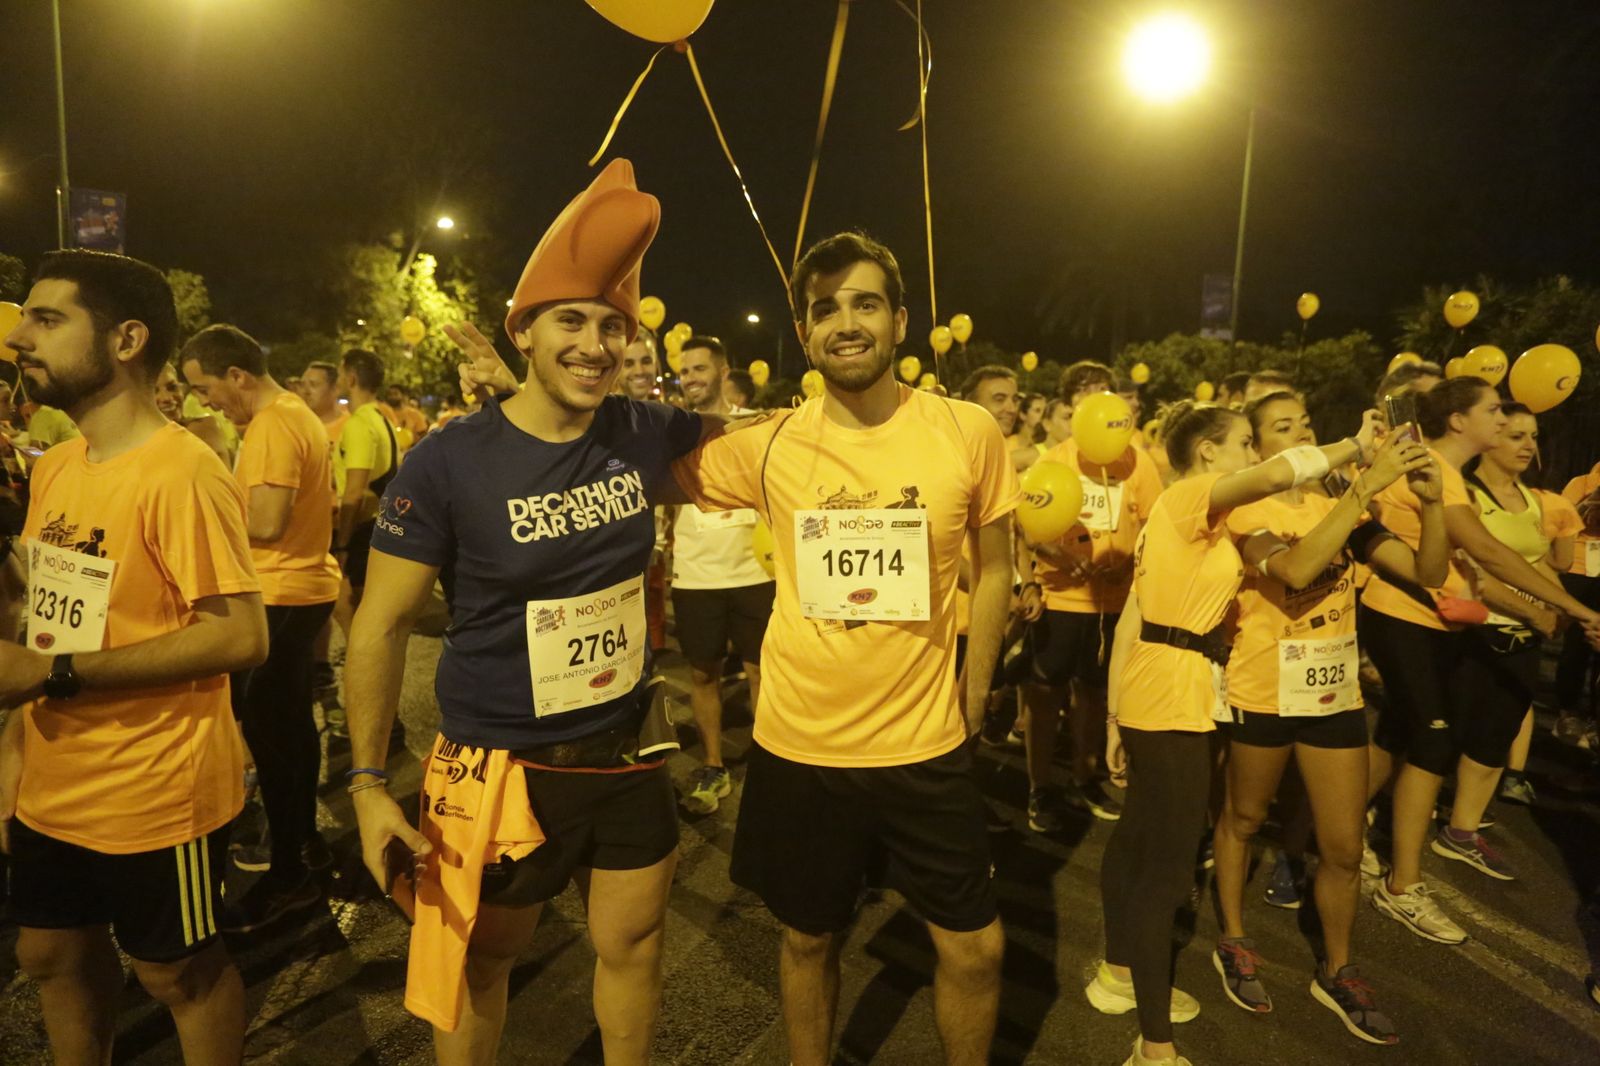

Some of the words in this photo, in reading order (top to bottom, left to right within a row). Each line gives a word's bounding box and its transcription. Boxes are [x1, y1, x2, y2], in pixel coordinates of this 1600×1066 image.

[1107, 418, 1129, 429] KH7
[507, 470, 644, 523] DECATHLON
[510, 516, 569, 544] CAR
[573, 490, 649, 532] SEVILLA
[822, 549, 905, 577] 16714
[567, 623, 629, 667] 2764
[538, 673, 561, 685] JOSE
[562, 665, 600, 680] ANTONIO
[592, 670, 614, 685] KH7
[1306, 663, 1345, 687] 8325
